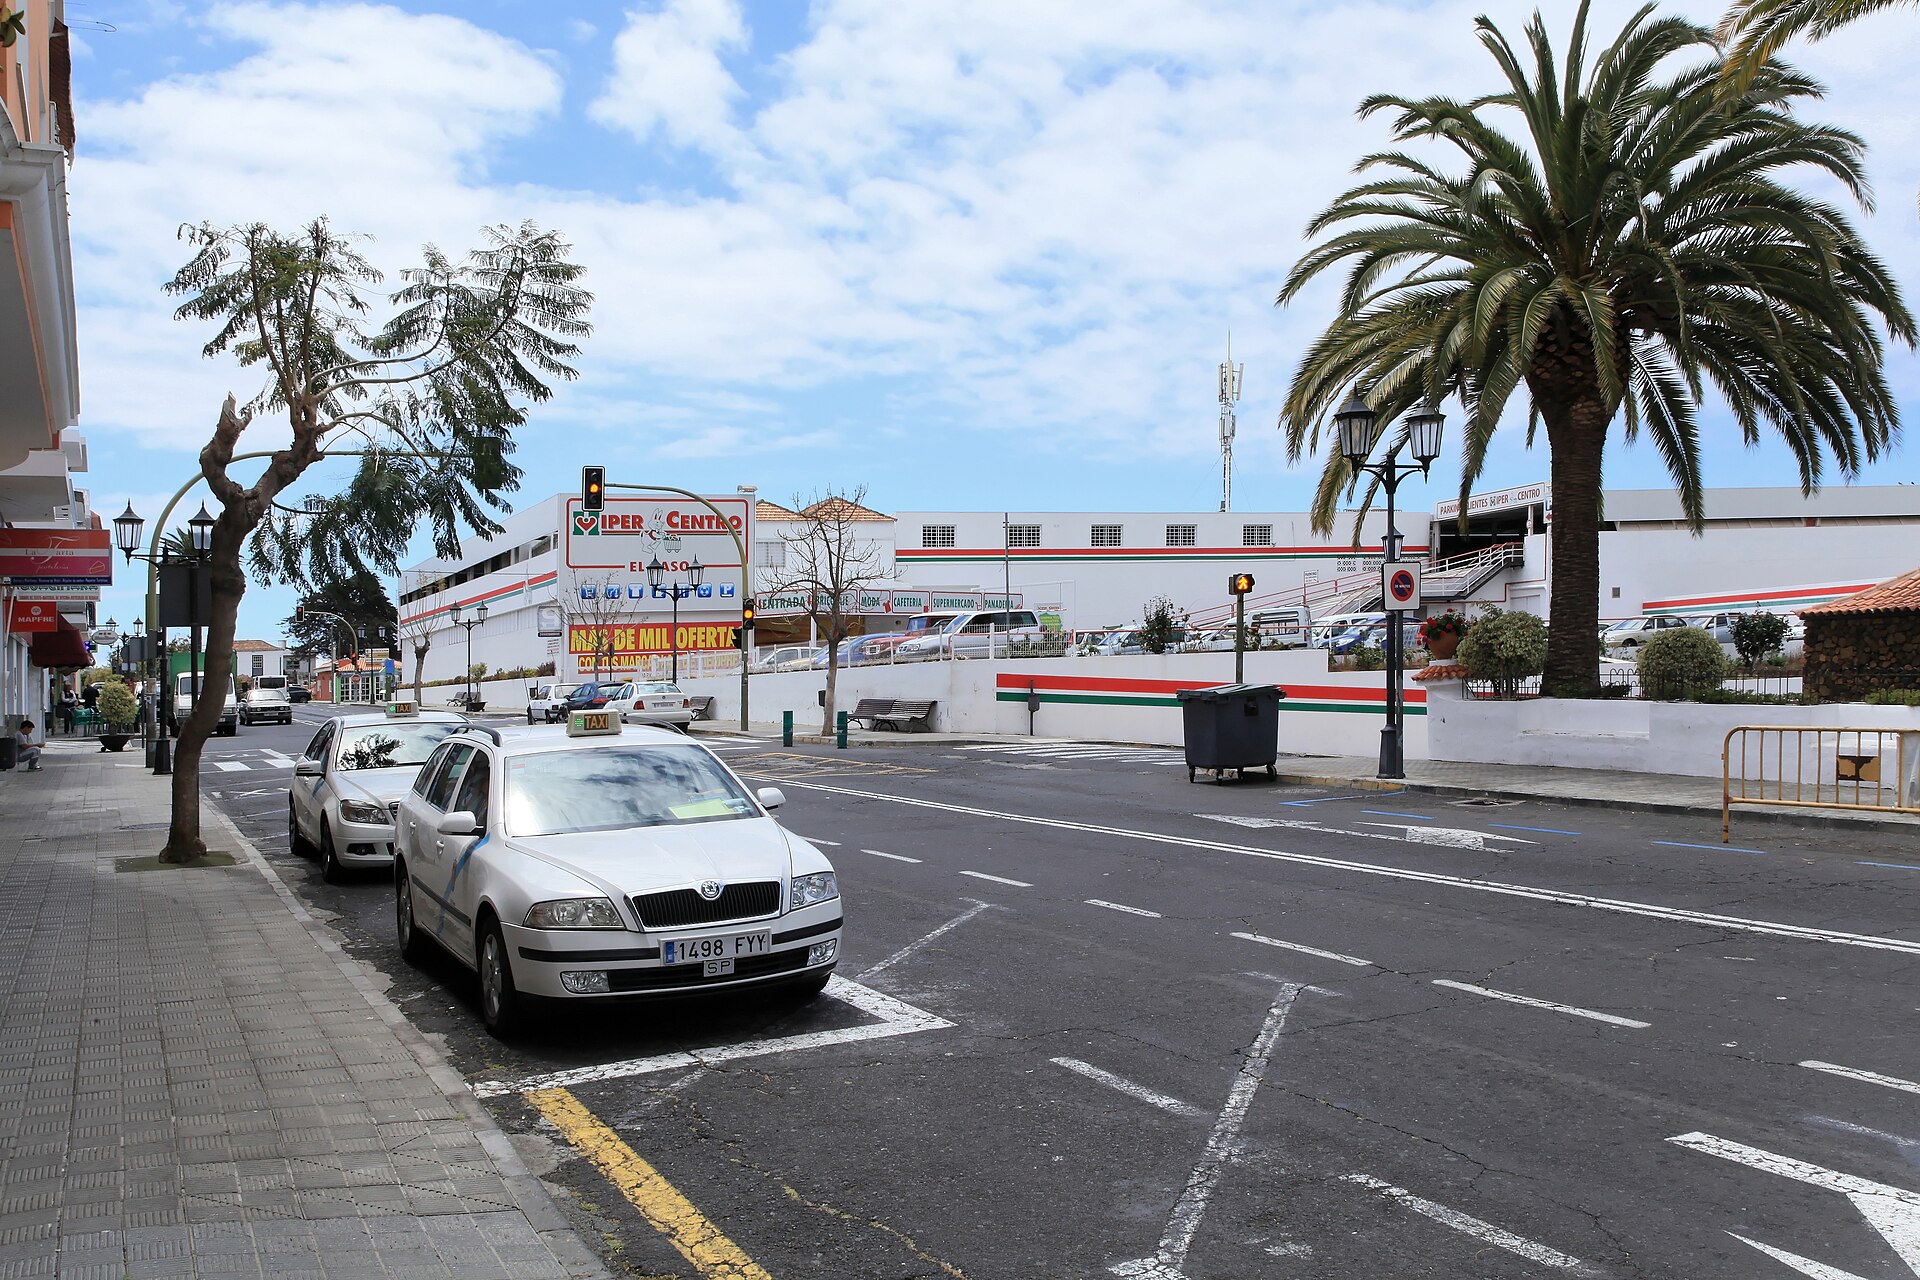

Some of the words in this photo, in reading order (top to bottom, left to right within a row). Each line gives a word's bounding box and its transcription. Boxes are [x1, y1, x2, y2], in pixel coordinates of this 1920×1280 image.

[1440, 502, 1463, 515] PARKIN
[1466, 498, 1488, 510] LIENTES
[1517, 488, 1540, 501] CENTRO
[666, 511, 742, 529] CENTRO
[629, 561, 645, 572] EL
[660, 561, 690, 572] ASO
[762, 596, 806, 610] ENTRADA
[860, 597, 880, 607] MODA
[893, 597, 922, 607] CAFETERIA
[933, 598, 975, 609] SUPERMERCADO
[570, 625, 609, 652] MÁS
[614, 628, 636, 651] DE
[638, 627, 671, 650] MIL
[676, 626, 739, 649] OFERTA
[620, 654, 655, 671] MARCA
[396, 704, 411, 713] TAXI
[584, 714, 609, 729] TAXI
[679, 939, 724, 960] 1498
[735, 934, 766, 954] FYY
[707, 960, 731, 974] SP
